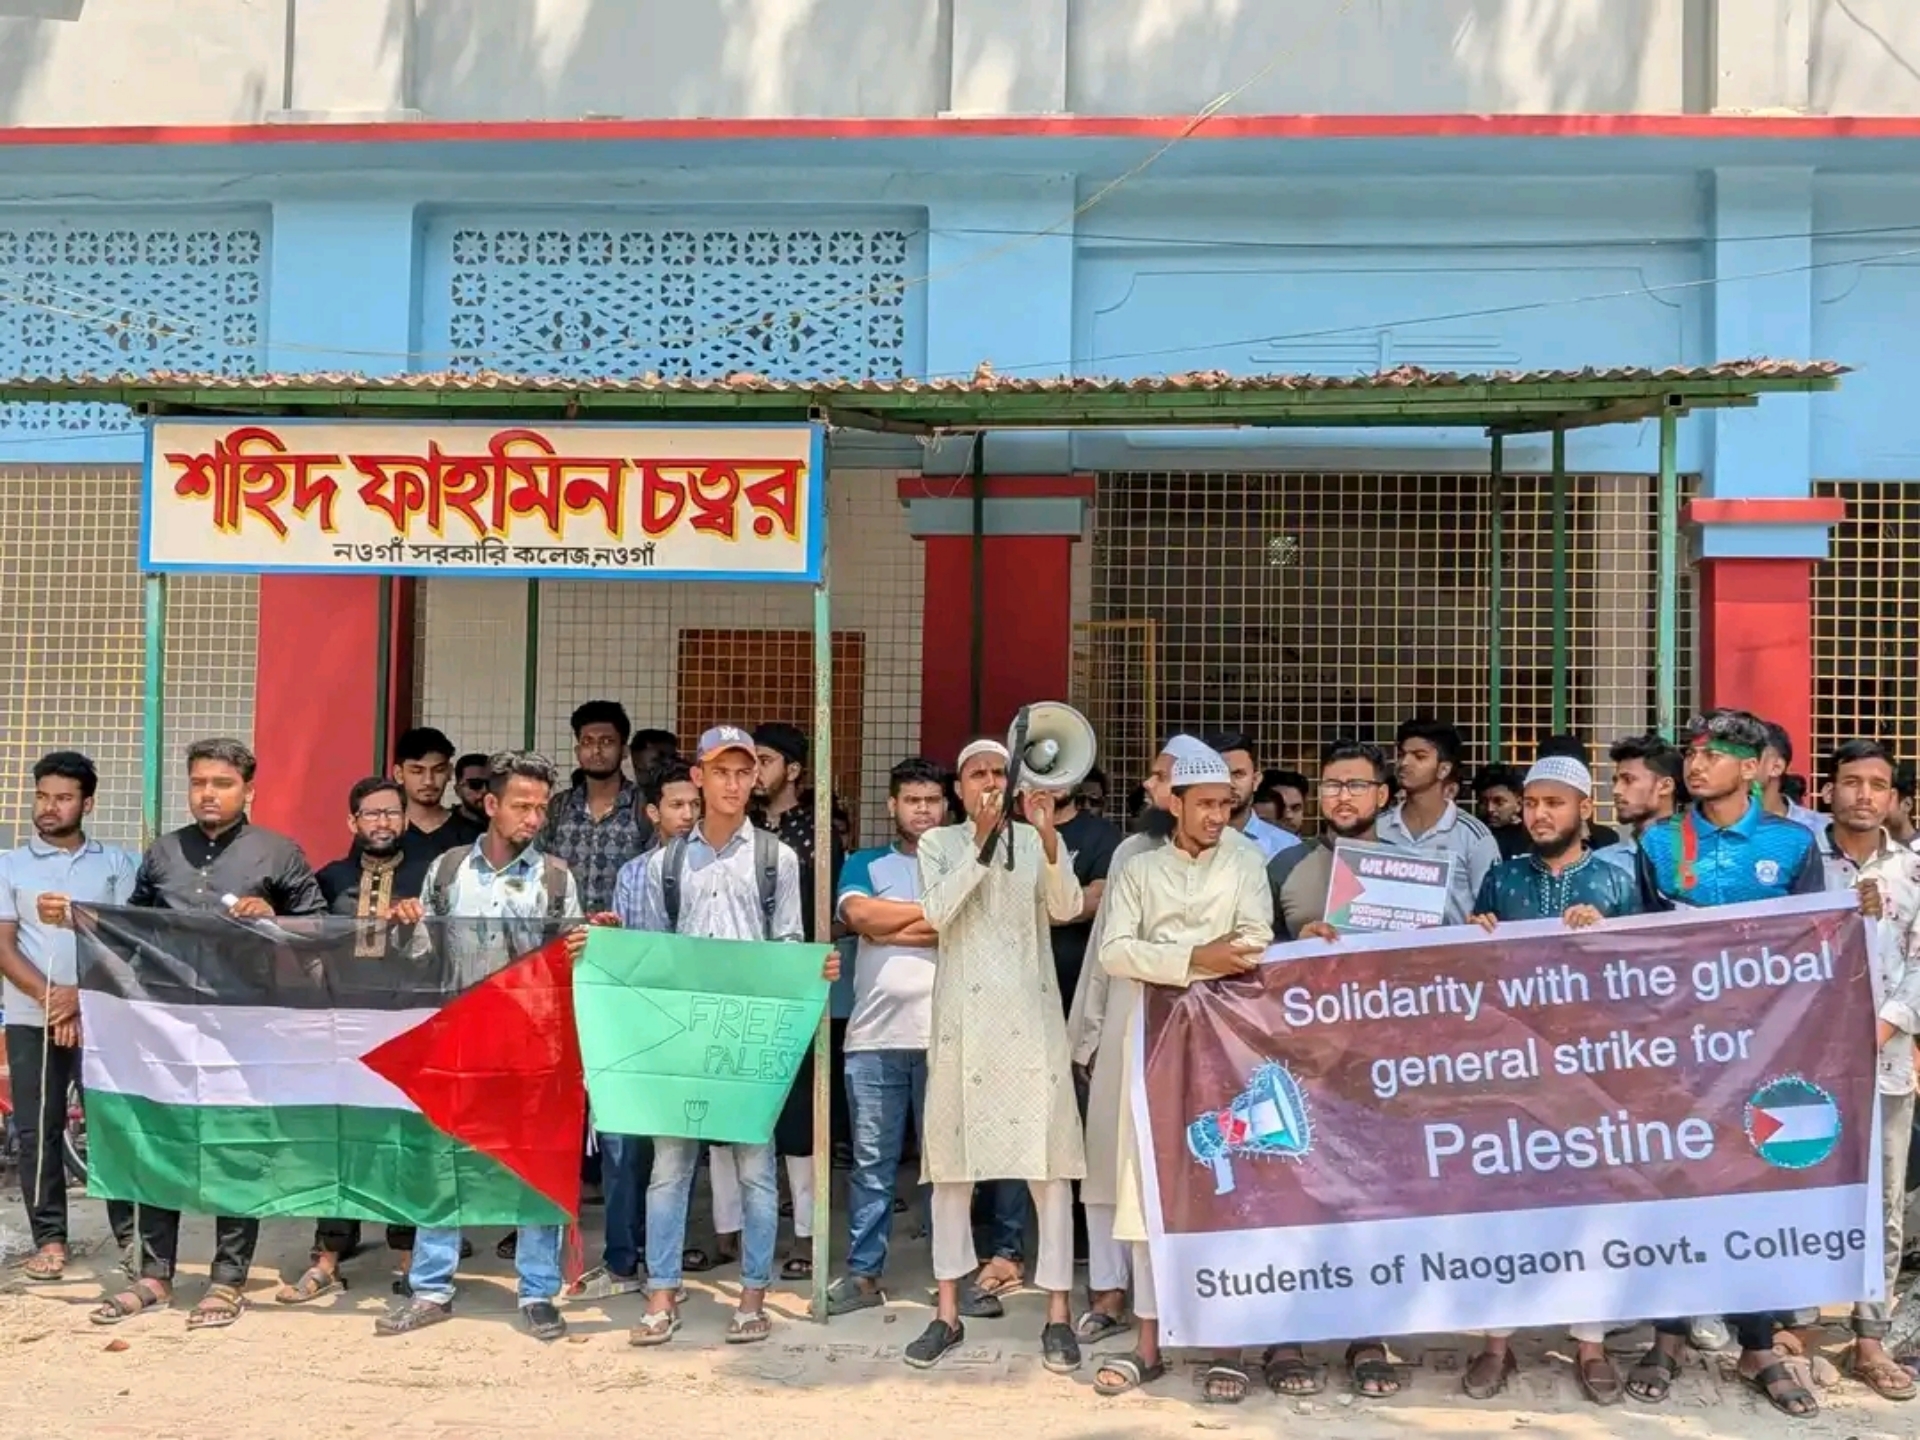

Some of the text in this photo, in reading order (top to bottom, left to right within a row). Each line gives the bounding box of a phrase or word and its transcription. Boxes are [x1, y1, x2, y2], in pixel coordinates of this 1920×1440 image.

[164, 427, 808, 543] শহিদ ফাহমিন চত্বর
[333, 535, 405, 562] নওগাঁ
[408, 537, 508, 566] সরকারি
[1384, 860, 1441, 883] MOURN
[1283, 940, 1835, 1027] Solidarity with the global
[689, 995, 804, 1048] FREE
[1370, 1024, 1754, 1098] general strike for
[1424, 1110, 1715, 1178] Palestine
[1195, 1227, 1866, 1298] Students of Naogaon Govt. College
